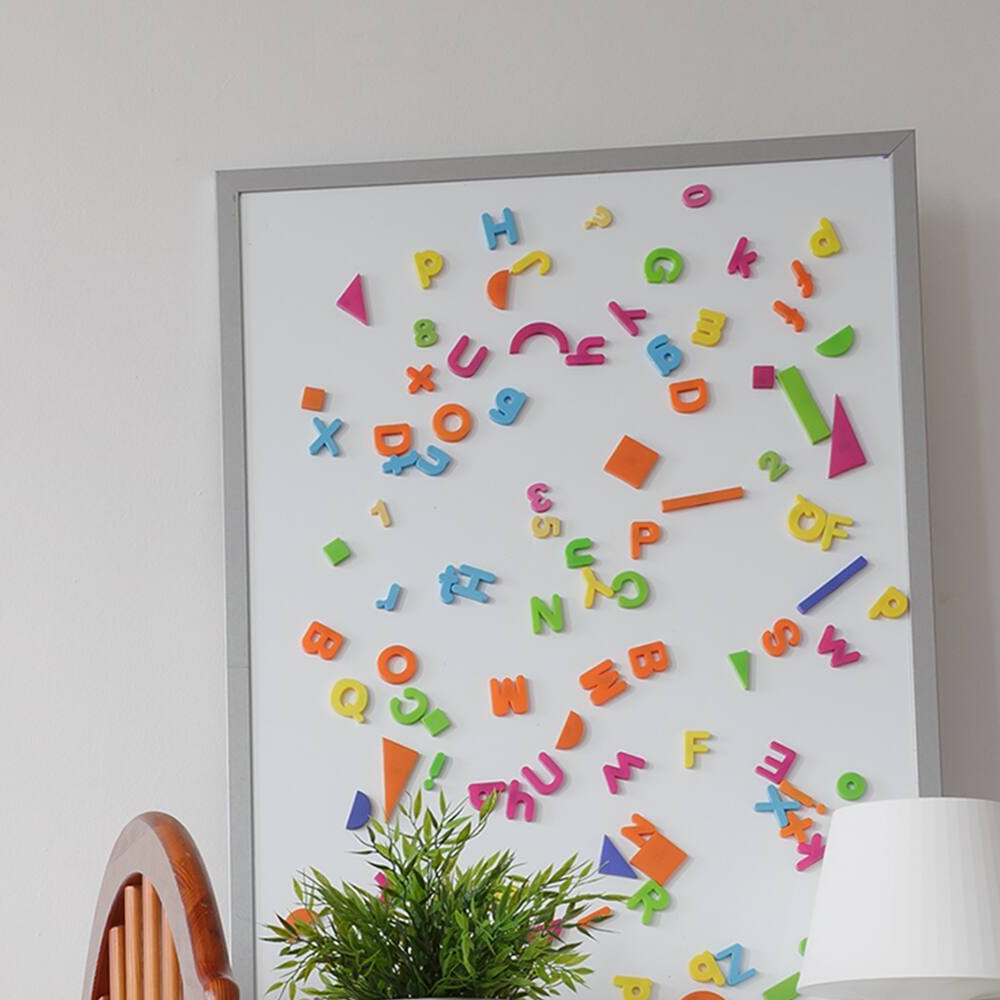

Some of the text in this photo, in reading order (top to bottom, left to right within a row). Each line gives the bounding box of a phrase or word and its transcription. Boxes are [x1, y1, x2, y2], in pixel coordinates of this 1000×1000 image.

[481, 207, 519, 251] H
[631, 520, 662, 561] P
[530, 593, 565, 635] N
[301, 621, 345, 661] B
[628, 641, 671, 680] B
[330, 678, 370, 724] Q
[683, 731, 711, 769] F
[626, 879, 671, 926] R
